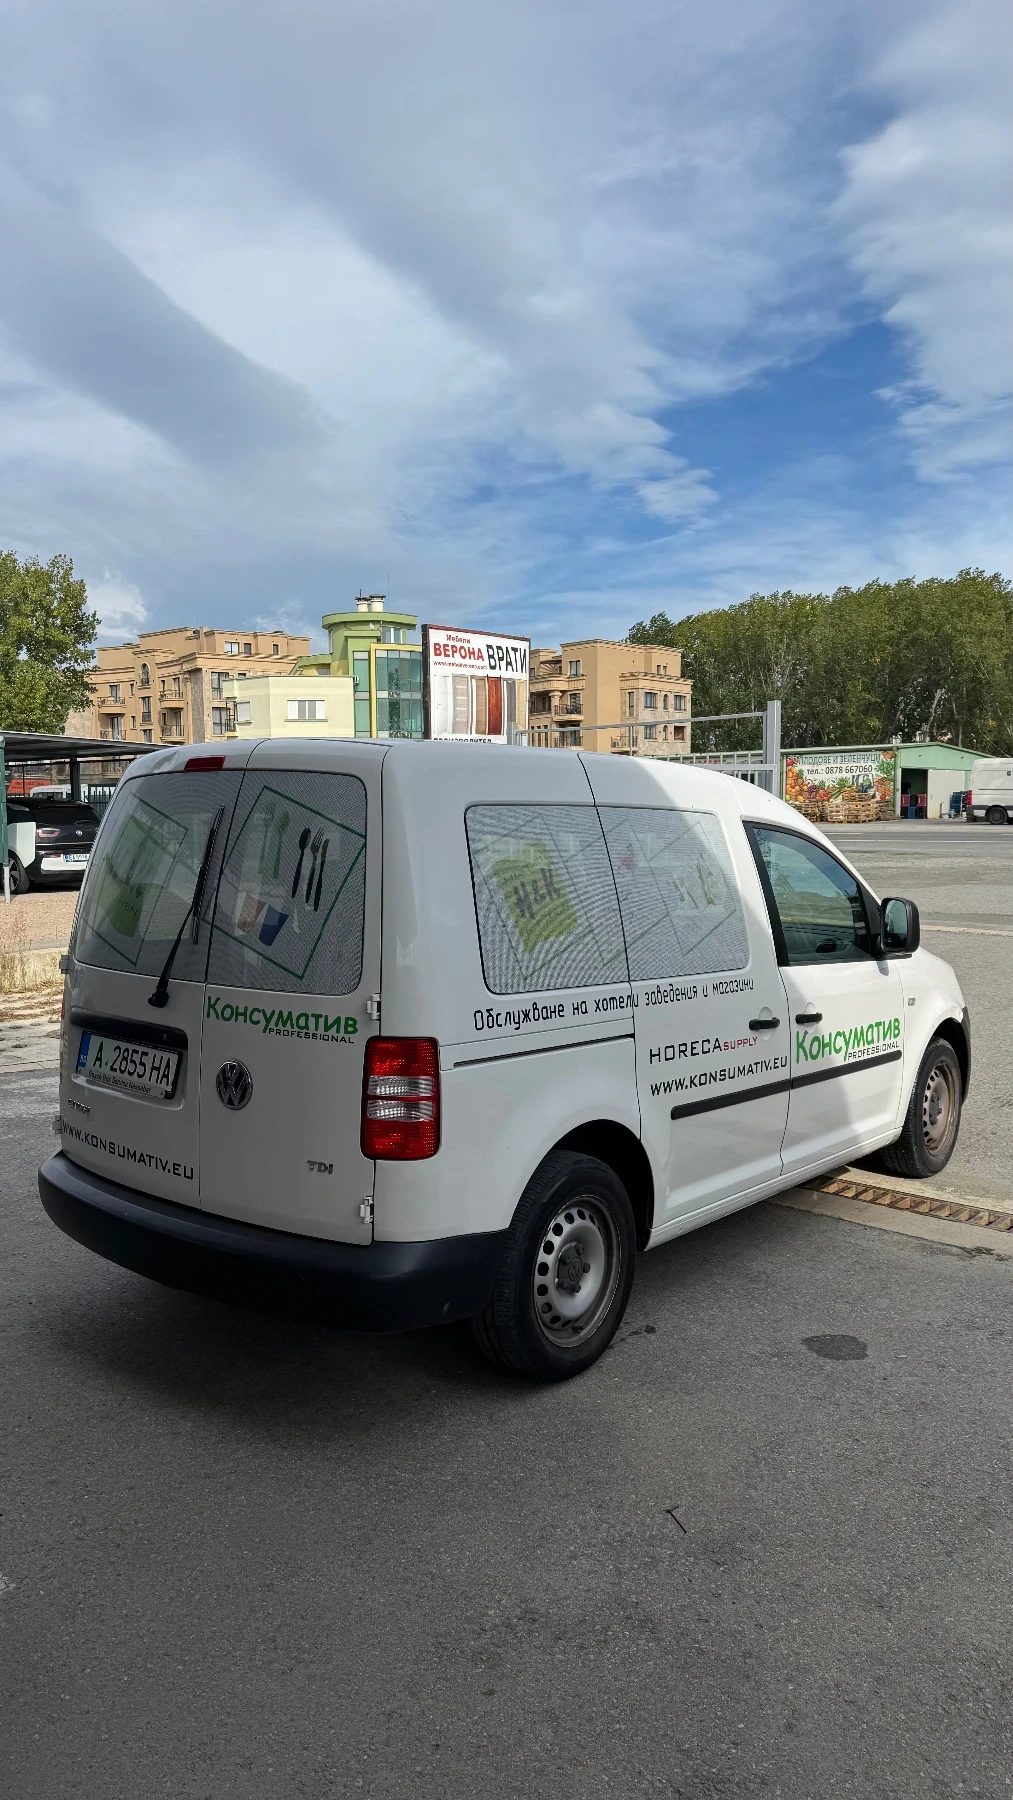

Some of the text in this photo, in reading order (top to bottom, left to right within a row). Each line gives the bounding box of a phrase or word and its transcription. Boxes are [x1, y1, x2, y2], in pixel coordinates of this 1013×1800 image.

[433, 642, 485, 661] ВЕРОНА
[446, 634, 471, 644] Мебели
[486, 644, 527, 674] ВРАТИ
[799, 753, 881, 766] ПЛОДОВЕ И ЗЕЛЕНЧУЦИ
[825, 766, 843, 775] 0878
[844, 765, 873, 774] 667060
[206, 995, 359, 1035] Консуматив
[473, 978, 755, 1031] Обслужване на хотели заведения и магазини
[267, 1027, 355, 1044] PROFESSIONAL
[795, 1017, 901, 1064] Консуматив
[93, 1040, 171, 1087] A 2855 HA
[649, 1036, 758, 1065] HORECA SUPPLY
[847, 1040, 900, 1061] PROFESSIONAL
[650, 1055, 788, 1096] WWW.KONSUMATIV.EU
[62, 1118, 195, 1181] WWW.KONSUMATIV.EU
[306, 1160, 334, 1175] TDI
